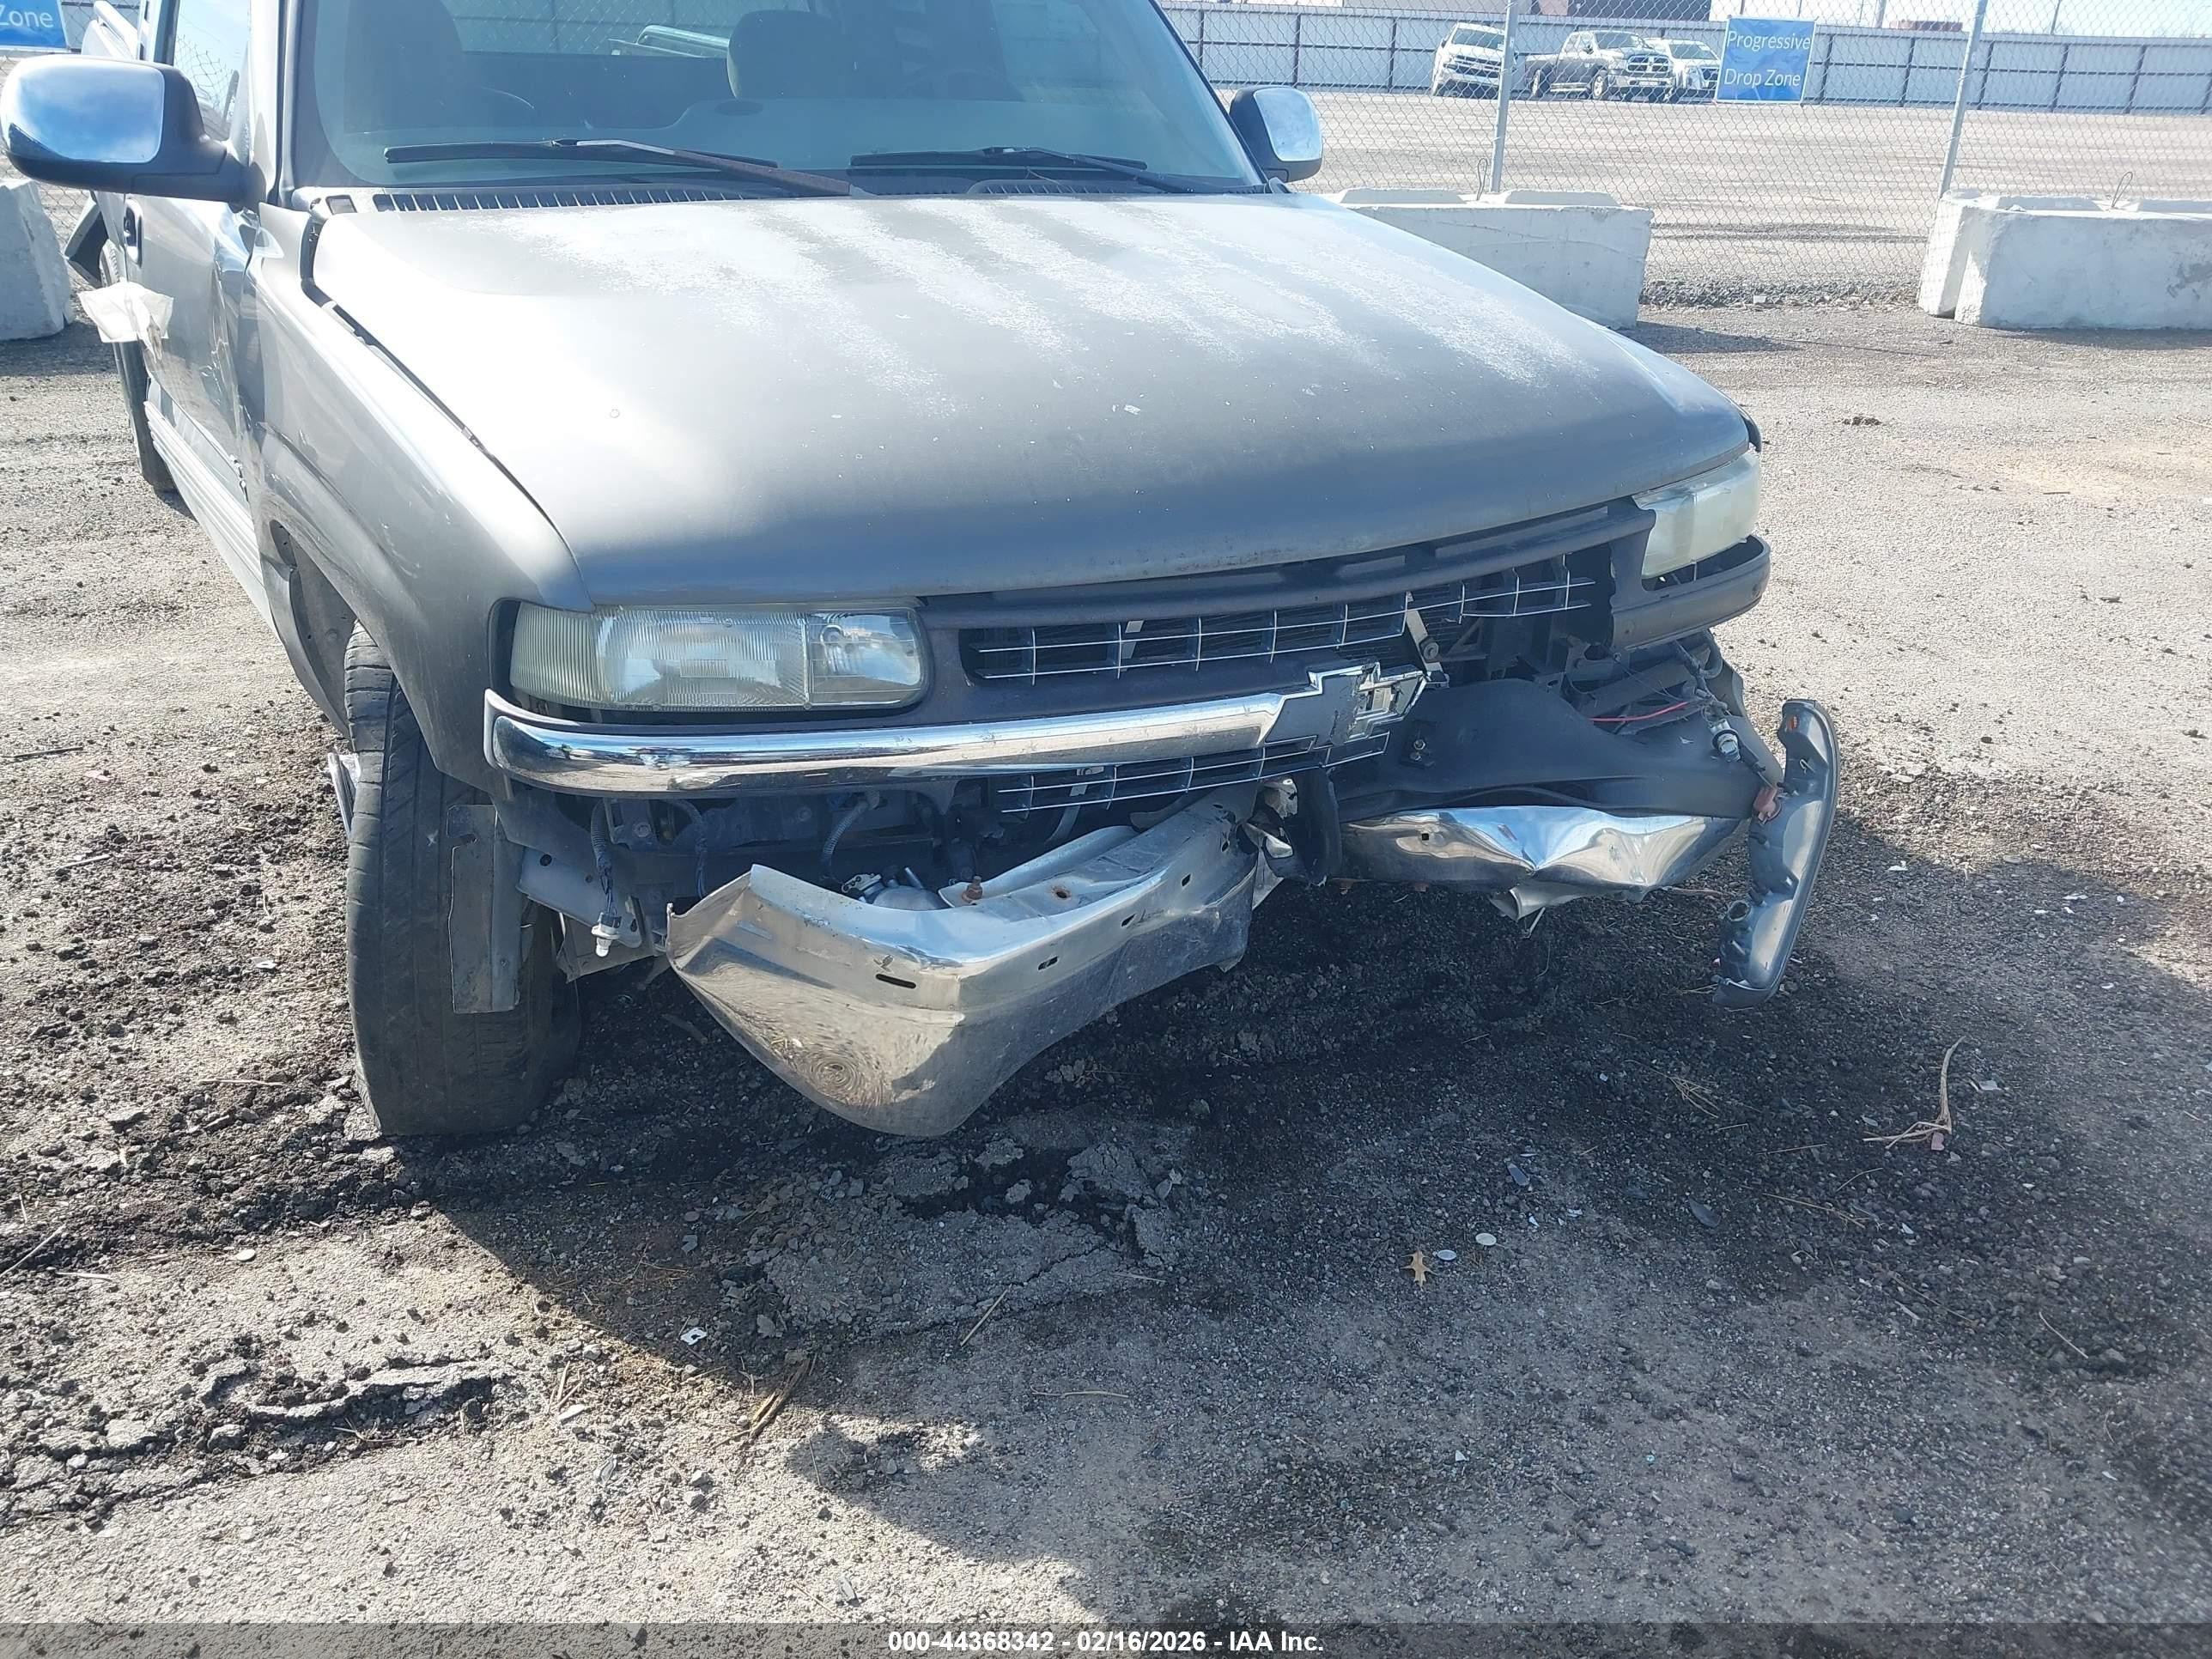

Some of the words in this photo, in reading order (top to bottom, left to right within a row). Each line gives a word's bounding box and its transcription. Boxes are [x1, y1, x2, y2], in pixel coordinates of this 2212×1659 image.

[1726, 30, 1811, 52] Progressive
[1723, 68, 1762, 88] Drop
[1764, 69, 1801, 87] Zone
